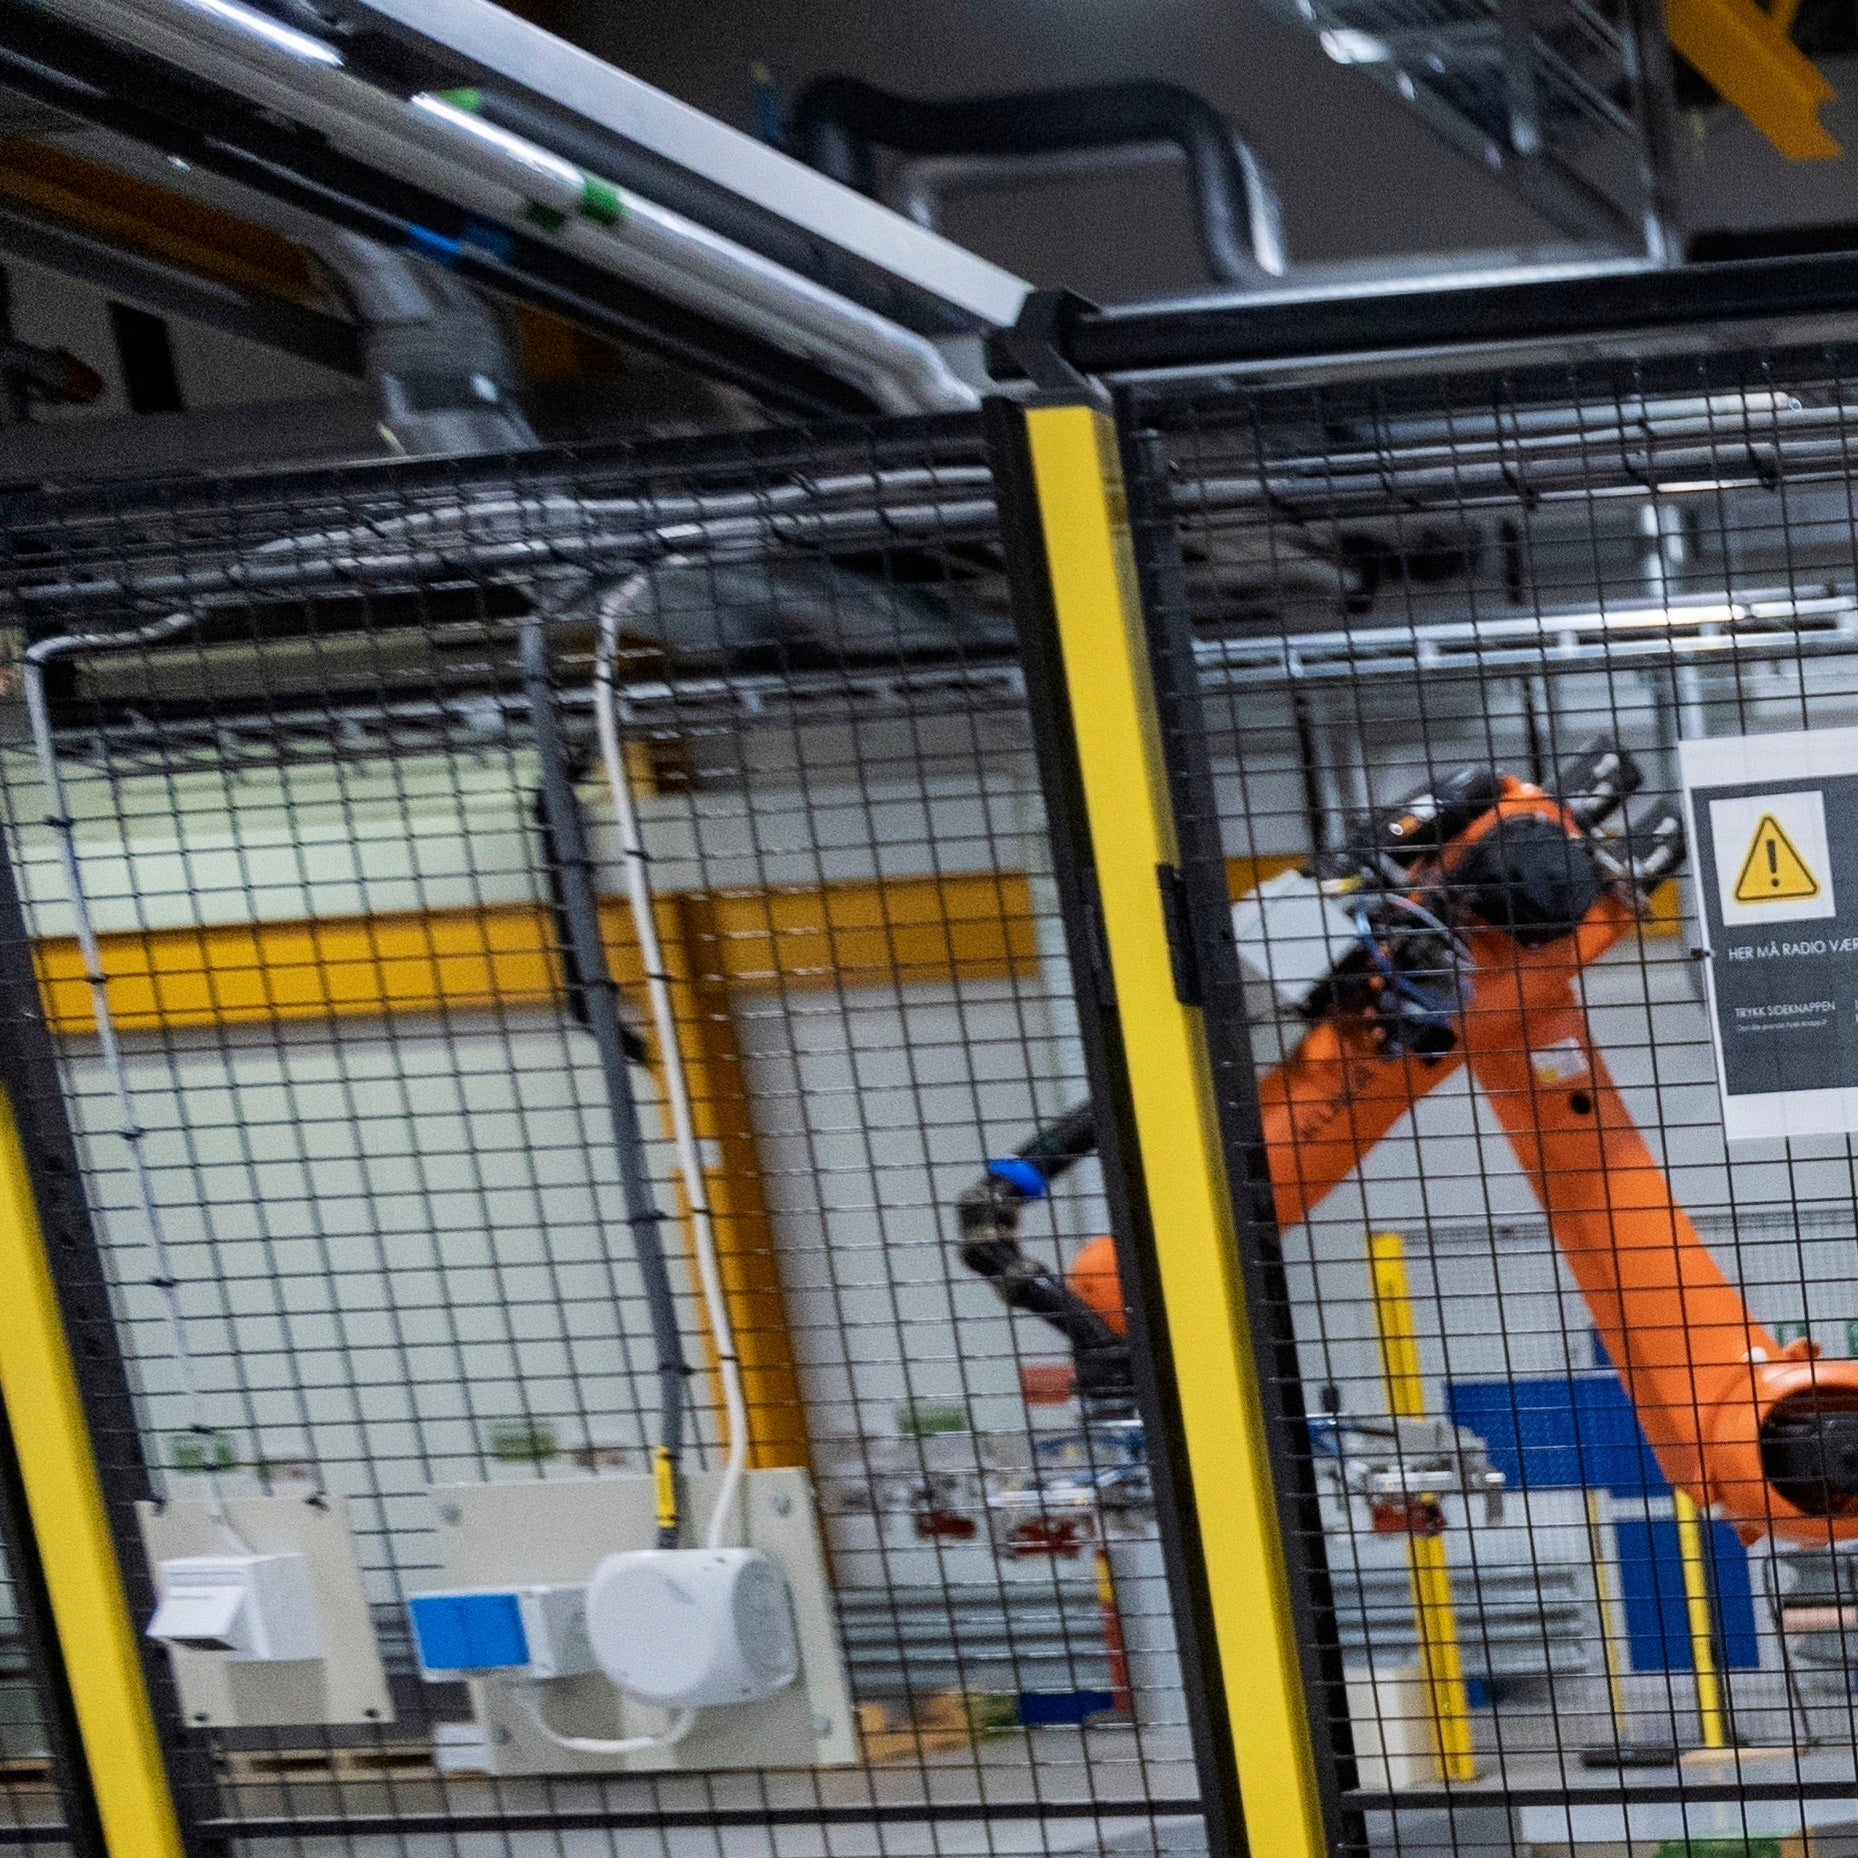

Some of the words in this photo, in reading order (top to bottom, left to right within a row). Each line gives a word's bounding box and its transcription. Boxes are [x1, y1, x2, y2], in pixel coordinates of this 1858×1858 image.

[1728, 947, 1754, 961] HER
[1757, 941, 1781, 958] MÅ
[1782, 941, 1826, 957] RADIO
[1767, 1000, 1836, 1016] SIDEKNAPPEN
